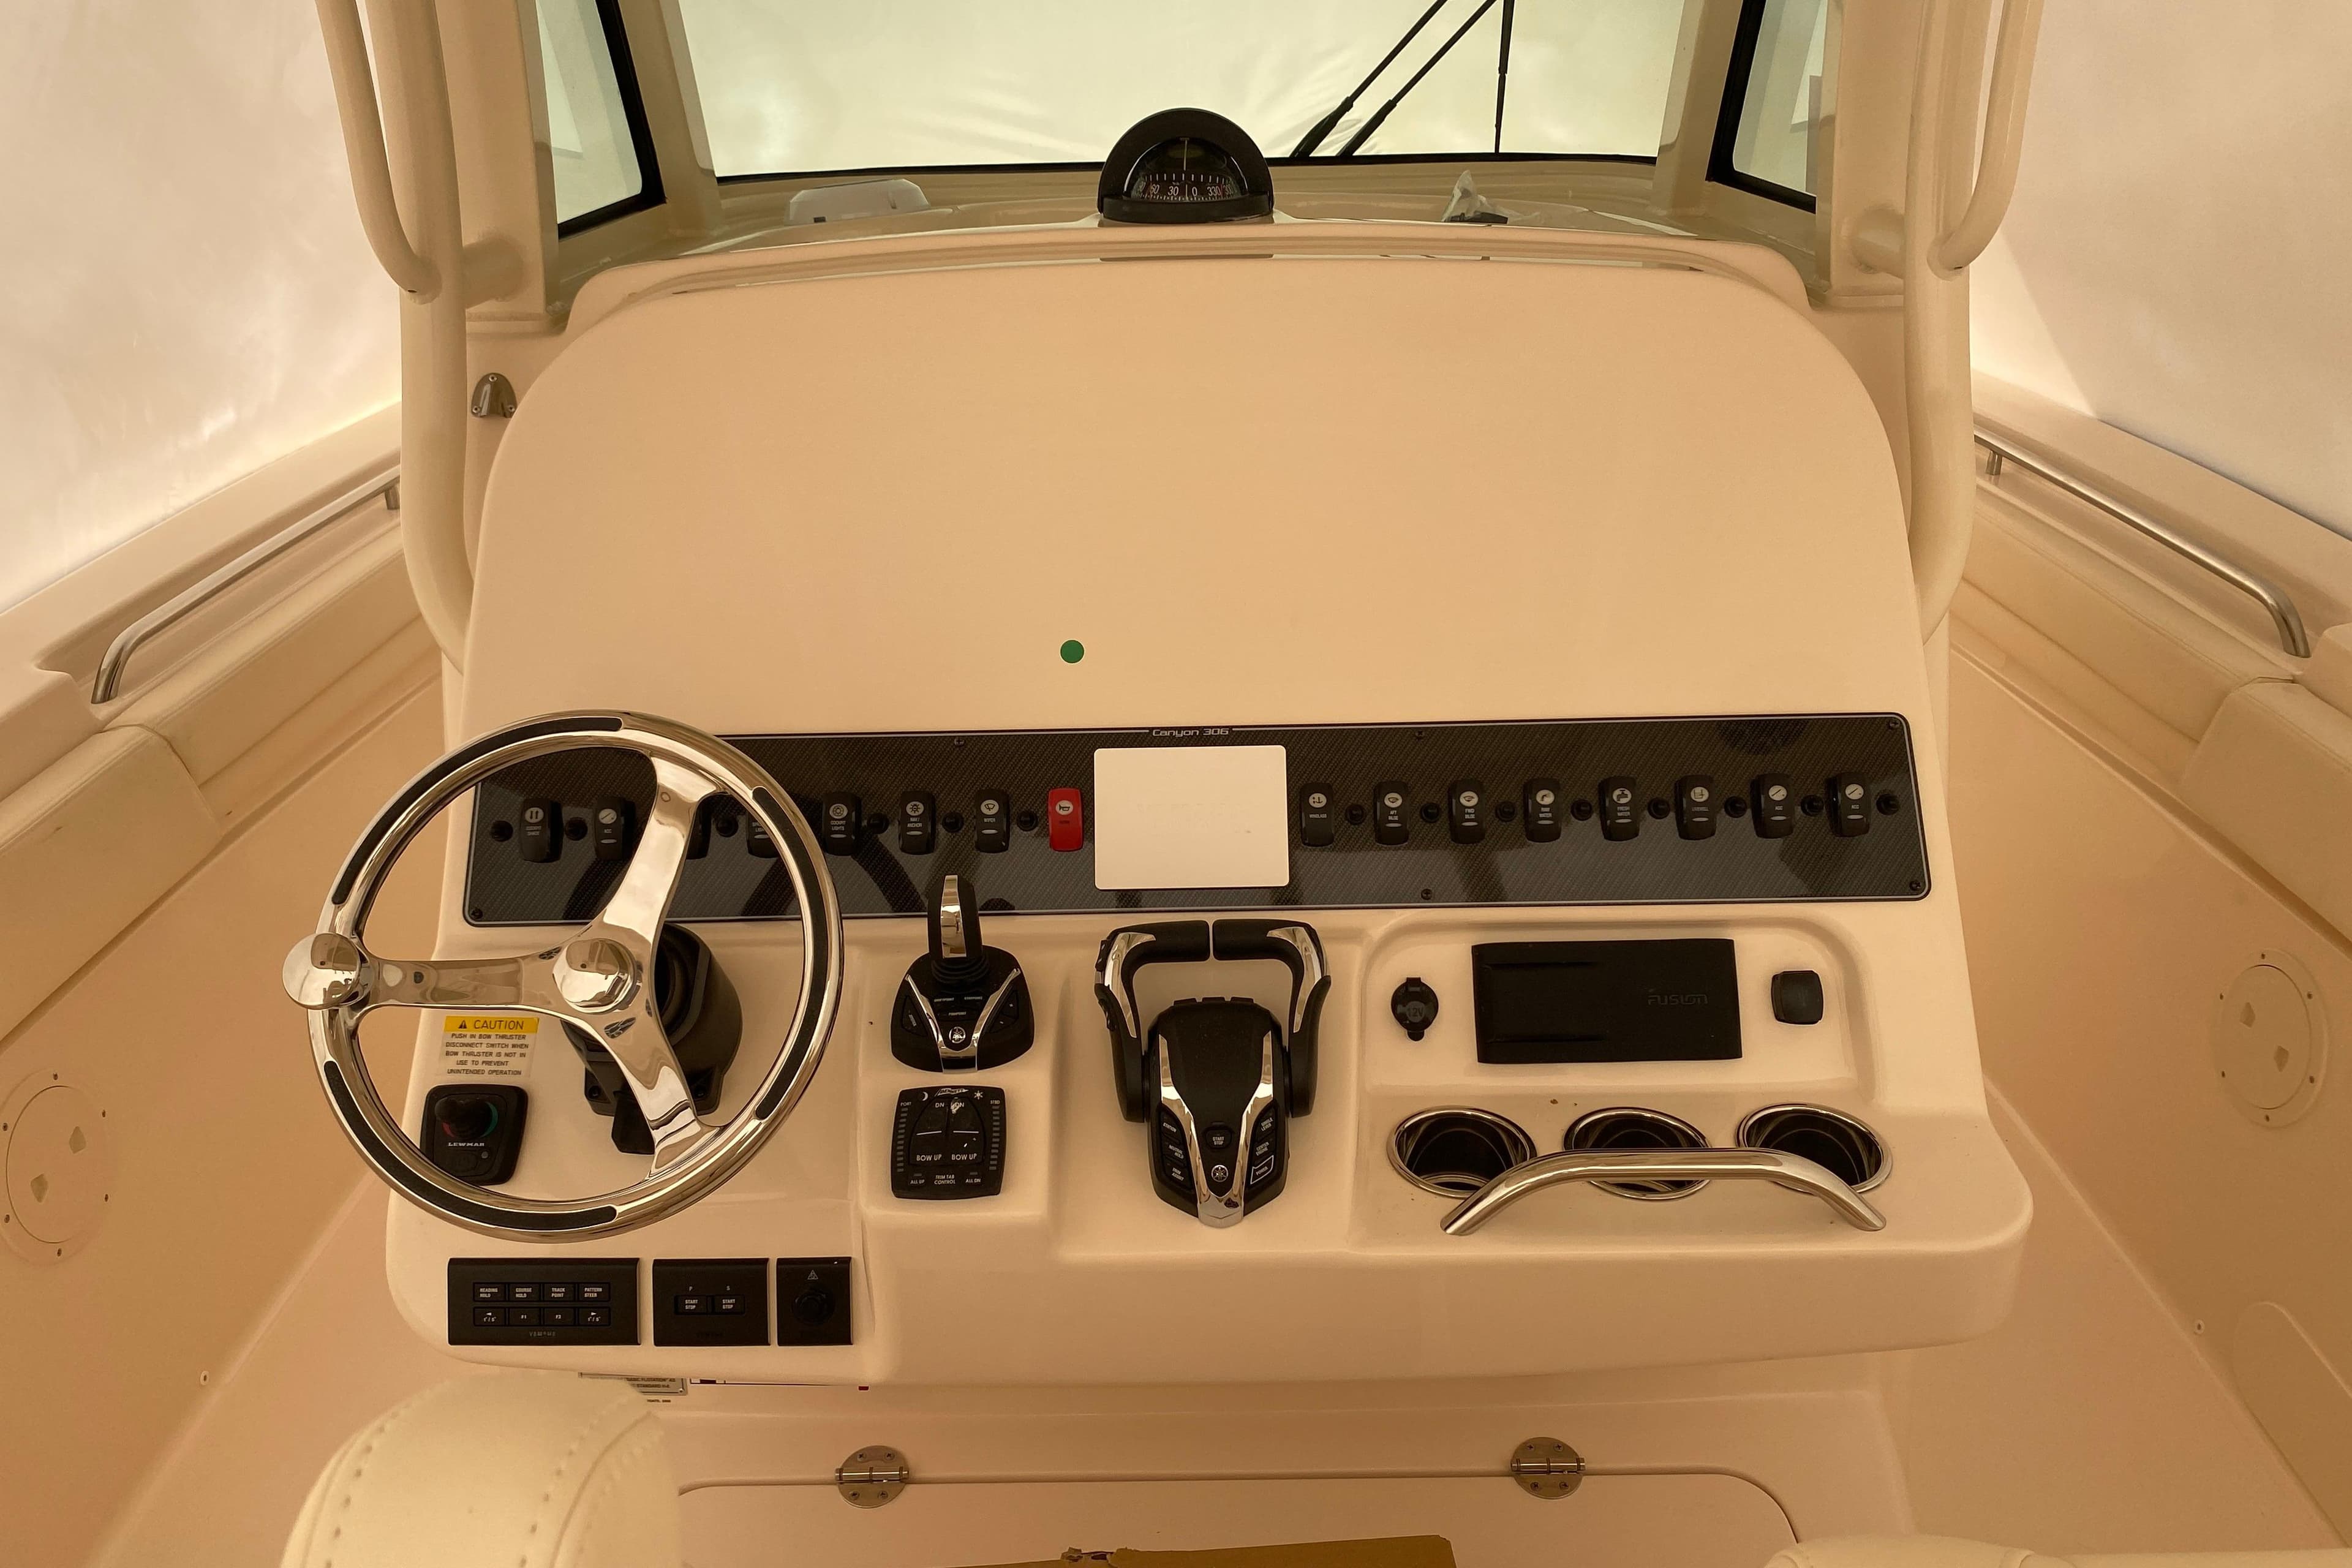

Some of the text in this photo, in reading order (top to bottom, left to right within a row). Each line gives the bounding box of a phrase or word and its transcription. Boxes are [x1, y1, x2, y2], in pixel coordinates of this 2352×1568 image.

[1167, 186, 1179, 196] 30
[1191, 186, 1198, 197] 0
[1207, 186, 1221, 196] 330
[1648, 994, 1708, 1005] FUSION
[473, 1019, 524, 1030] CAUTION
